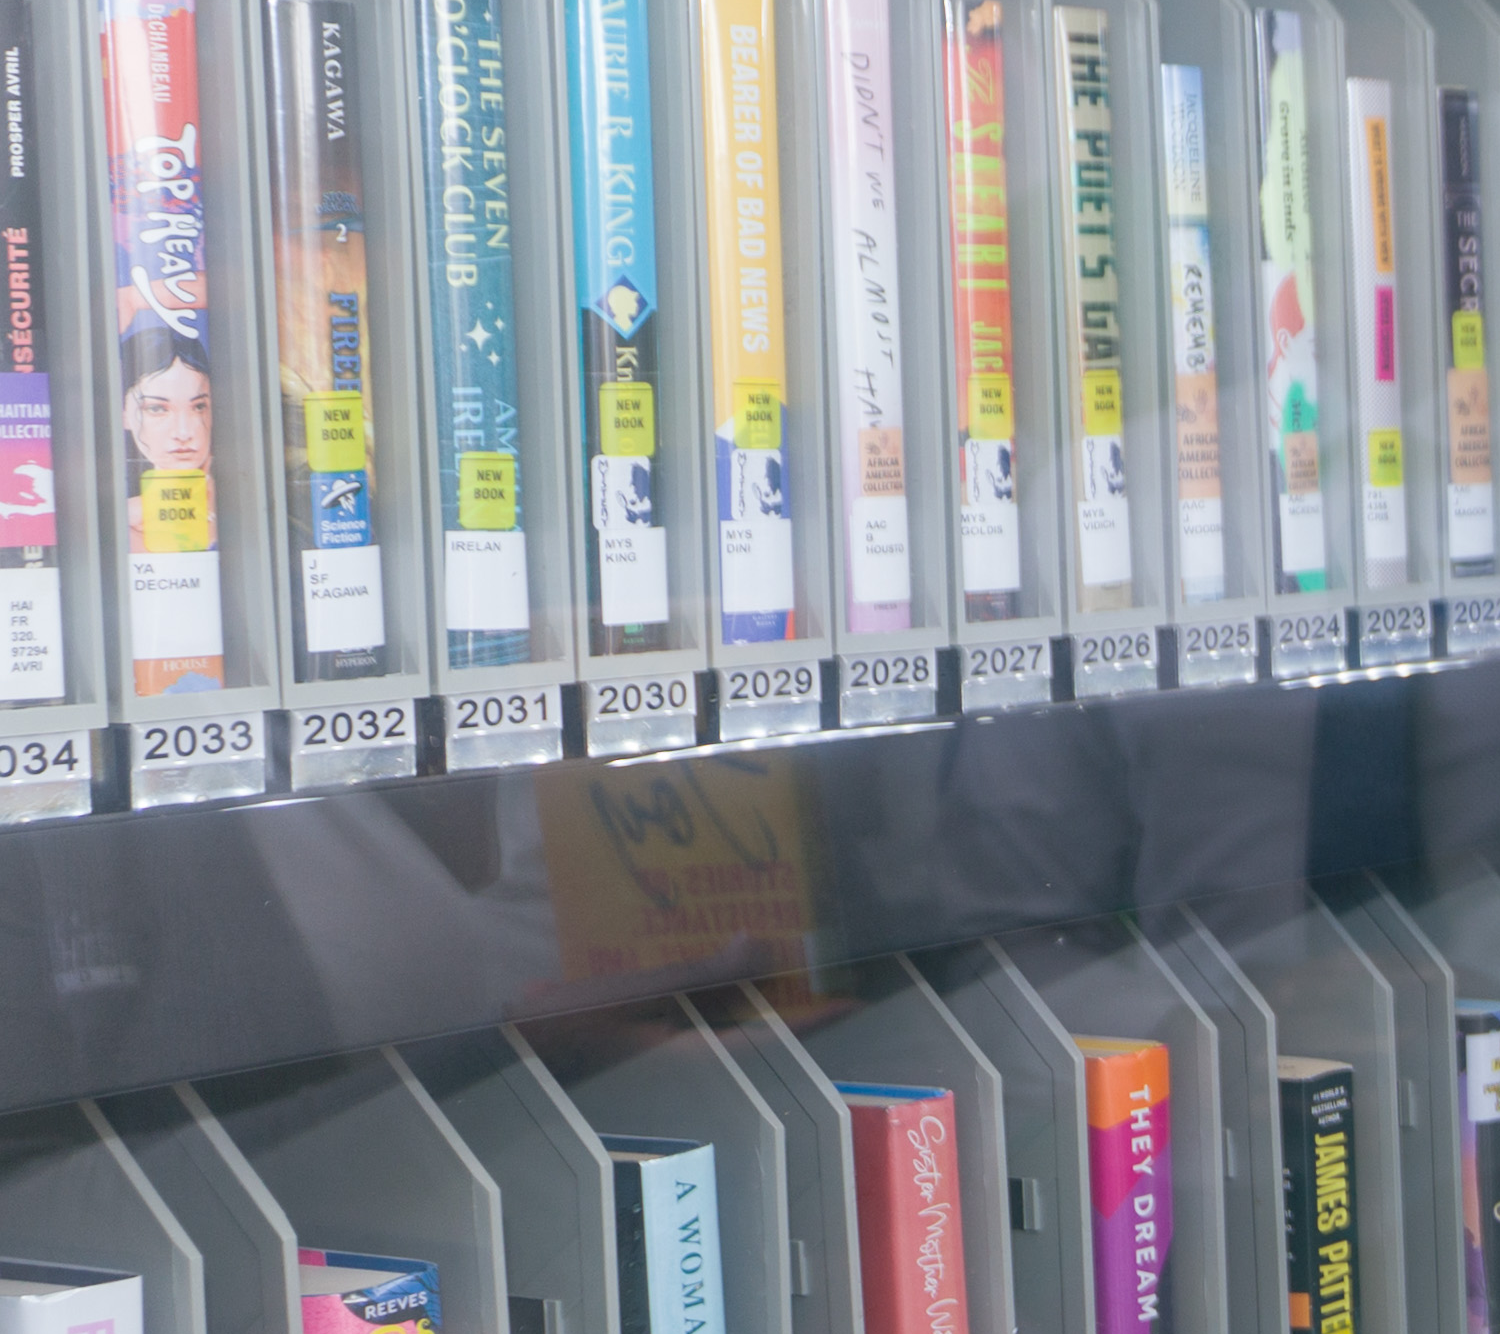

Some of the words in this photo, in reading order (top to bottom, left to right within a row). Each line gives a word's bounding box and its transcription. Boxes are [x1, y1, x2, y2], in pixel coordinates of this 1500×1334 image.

[4, 46, 21, 97] AVRIL
[321, 21, 346, 142] KAGAWA
[477, 34, 504, 112] THE
[729, 24, 763, 145] BEARER
[10, 99, 26, 178] PROSPER
[607, 116, 633, 138] R
[735, 149, 764, 191] OF
[481, 127, 510, 250] SEVEN
[870, 171, 886, 211] WE
[604, 163, 636, 267] KING
[737, 196, 766, 259] BAD
[335, 223, 347, 243] 2
[442, 185, 479, 288] CLUB
[740, 267, 770, 355] NEWS
[852, 228, 894, 369] ALMOST
[616, 399, 641, 413] NEW
[748, 393, 770, 406] NEW
[981, 388, 1002, 400] NEW
[323, 409, 351, 423] NEW
[614, 416, 645, 430] BOOK
[746, 410, 773, 423] BOOK
[979, 403, 1005, 416] BOOK
[322, 427, 355, 441] BOOK
[477, 469, 502, 483] NEW
[161, 488, 192, 501] NEW
[474, 488, 505, 501] BOOK
[158, 507, 197, 522] BOOK
[320, 518, 367, 534] Science
[321, 531, 363, 545] Fiction
[451, 540, 501, 553] IRELAN
[605, 538, 632, 549] MYS
[726, 528, 753, 540] MYS
[133, 563, 155, 575] YA
[605, 552, 637, 563] KING
[134, 577, 200, 591] DECHAM
[311, 585, 369, 600] KAGAWA
[11, 601, 32, 613] HAI
[1367, 607, 1426, 634] 2023
[11, 616, 28, 627] FR
[1279, 615, 1340, 644] 2024
[1082, 634, 1150, 664] 2026
[1186, 624, 1250, 652] 2025
[850, 655, 930, 688] 2028
[970, 644, 1043, 676] 2027
[599, 680, 688, 714] 2030
[730, 668, 813, 700] 2029
[457, 693, 548, 729] 2031
[304, 706, 406, 746] 2032
[144, 720, 254, 761] 2033
[1129, 1085, 1154, 1176] THEY
[675, 1180, 698, 1201] A
[1315, 1132, 1349, 1234] JAMES
[1133, 1194, 1160, 1322] DREAM
[365, 1291, 429, 1320] REEVES
